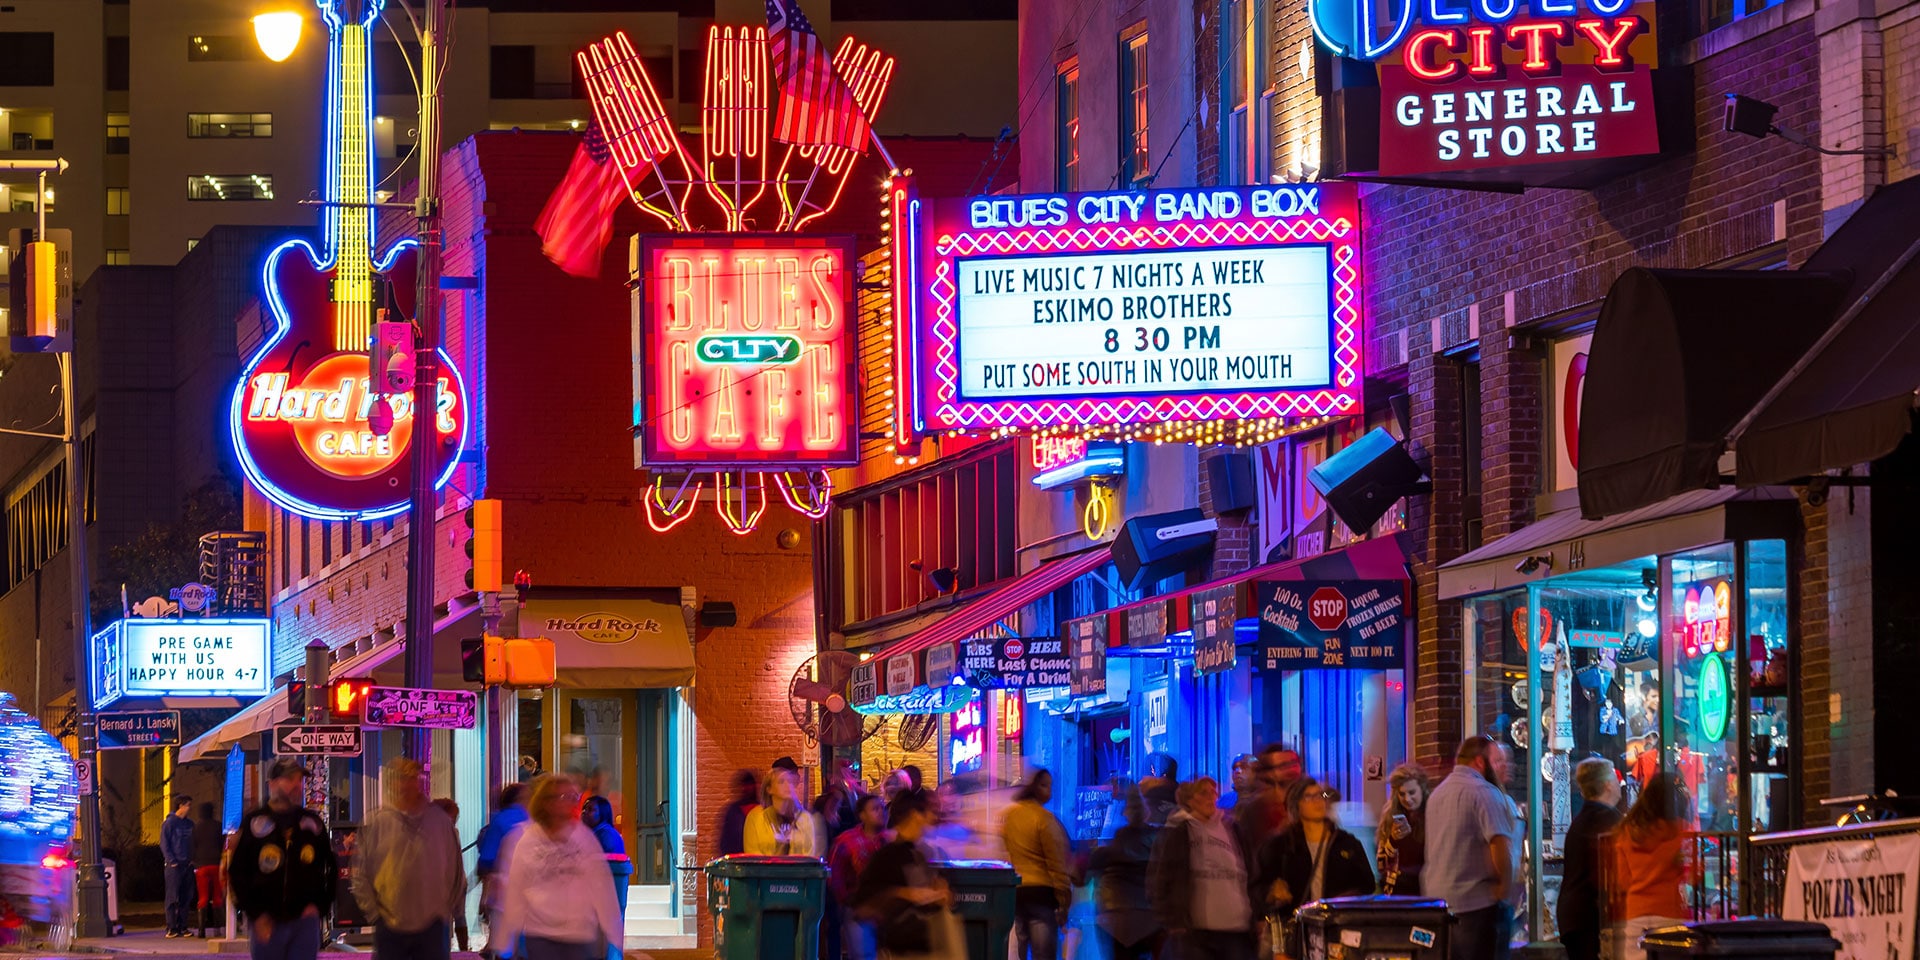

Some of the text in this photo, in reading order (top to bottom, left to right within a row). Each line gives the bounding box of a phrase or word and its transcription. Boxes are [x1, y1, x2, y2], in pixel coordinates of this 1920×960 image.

[1404, 16, 1638, 79] CITY
[1396, 82, 1636, 126] GENERAL
[1437, 121, 1597, 160] STORE
[971, 187, 1320, 228] BLUES CITY BAND BOX
[974, 259, 1265, 294] LIVE MUSIC 7 NIGHTS A WEEK
[665, 255, 835, 331] BLUES
[1033, 292, 1232, 324] ESKIMO BROTHERS
[1104, 325, 1221, 353] 8 30 PM
[703, 340, 793, 359] CITY
[983, 354, 1292, 389] PUT SOME SOUTH IN YOUR MOUTH
[668, 341, 835, 444] CAFE
[249, 373, 456, 433] Hard ok
[318, 433, 391, 456] CAFE
[1568, 541, 1585, 570] 144
[170, 588, 216, 600] Hard Rock
[1273, 587, 1291, 605] 100
[1351, 588, 1380, 609] LIQUOR
[1263, 604, 1299, 632] Cocktails
[1313, 599, 1343, 617] STOP
[1346, 595, 1402, 629] FROZEN DRINKS
[546, 618, 662, 633] Hard Rock
[1359, 614, 1397, 640] BIG BEER
[159, 636, 233, 649] PRE GAME
[1324, 638, 1341, 651] FUN
[1572, 632, 1607, 643] ATM
[151, 652, 214, 665] WITH US
[1006, 646, 1022, 654] STOP
[1267, 647, 1301, 659] ENTERING
[1304, 647, 1318, 658] THE
[1350, 646, 1369, 657] NEXT
[1370, 646, 1382, 657] 100
[1323, 652, 1344, 665] ZONE
[965, 656, 996, 669] HERE
[997, 658, 1028, 671] Last
[129, 668, 258, 681] HAPPY HOUR 4-7
[1003, 672, 1024, 686] For
[1026, 672, 1036, 685] A
[1150, 695, 1166, 728] ATM
[100, 716, 177, 731] Bernard J. Lansky
[128, 733, 154, 742] STREET
[302, 734, 352, 745] ONE WAY
[1802, 873, 1906, 921] POKER NIGHT
